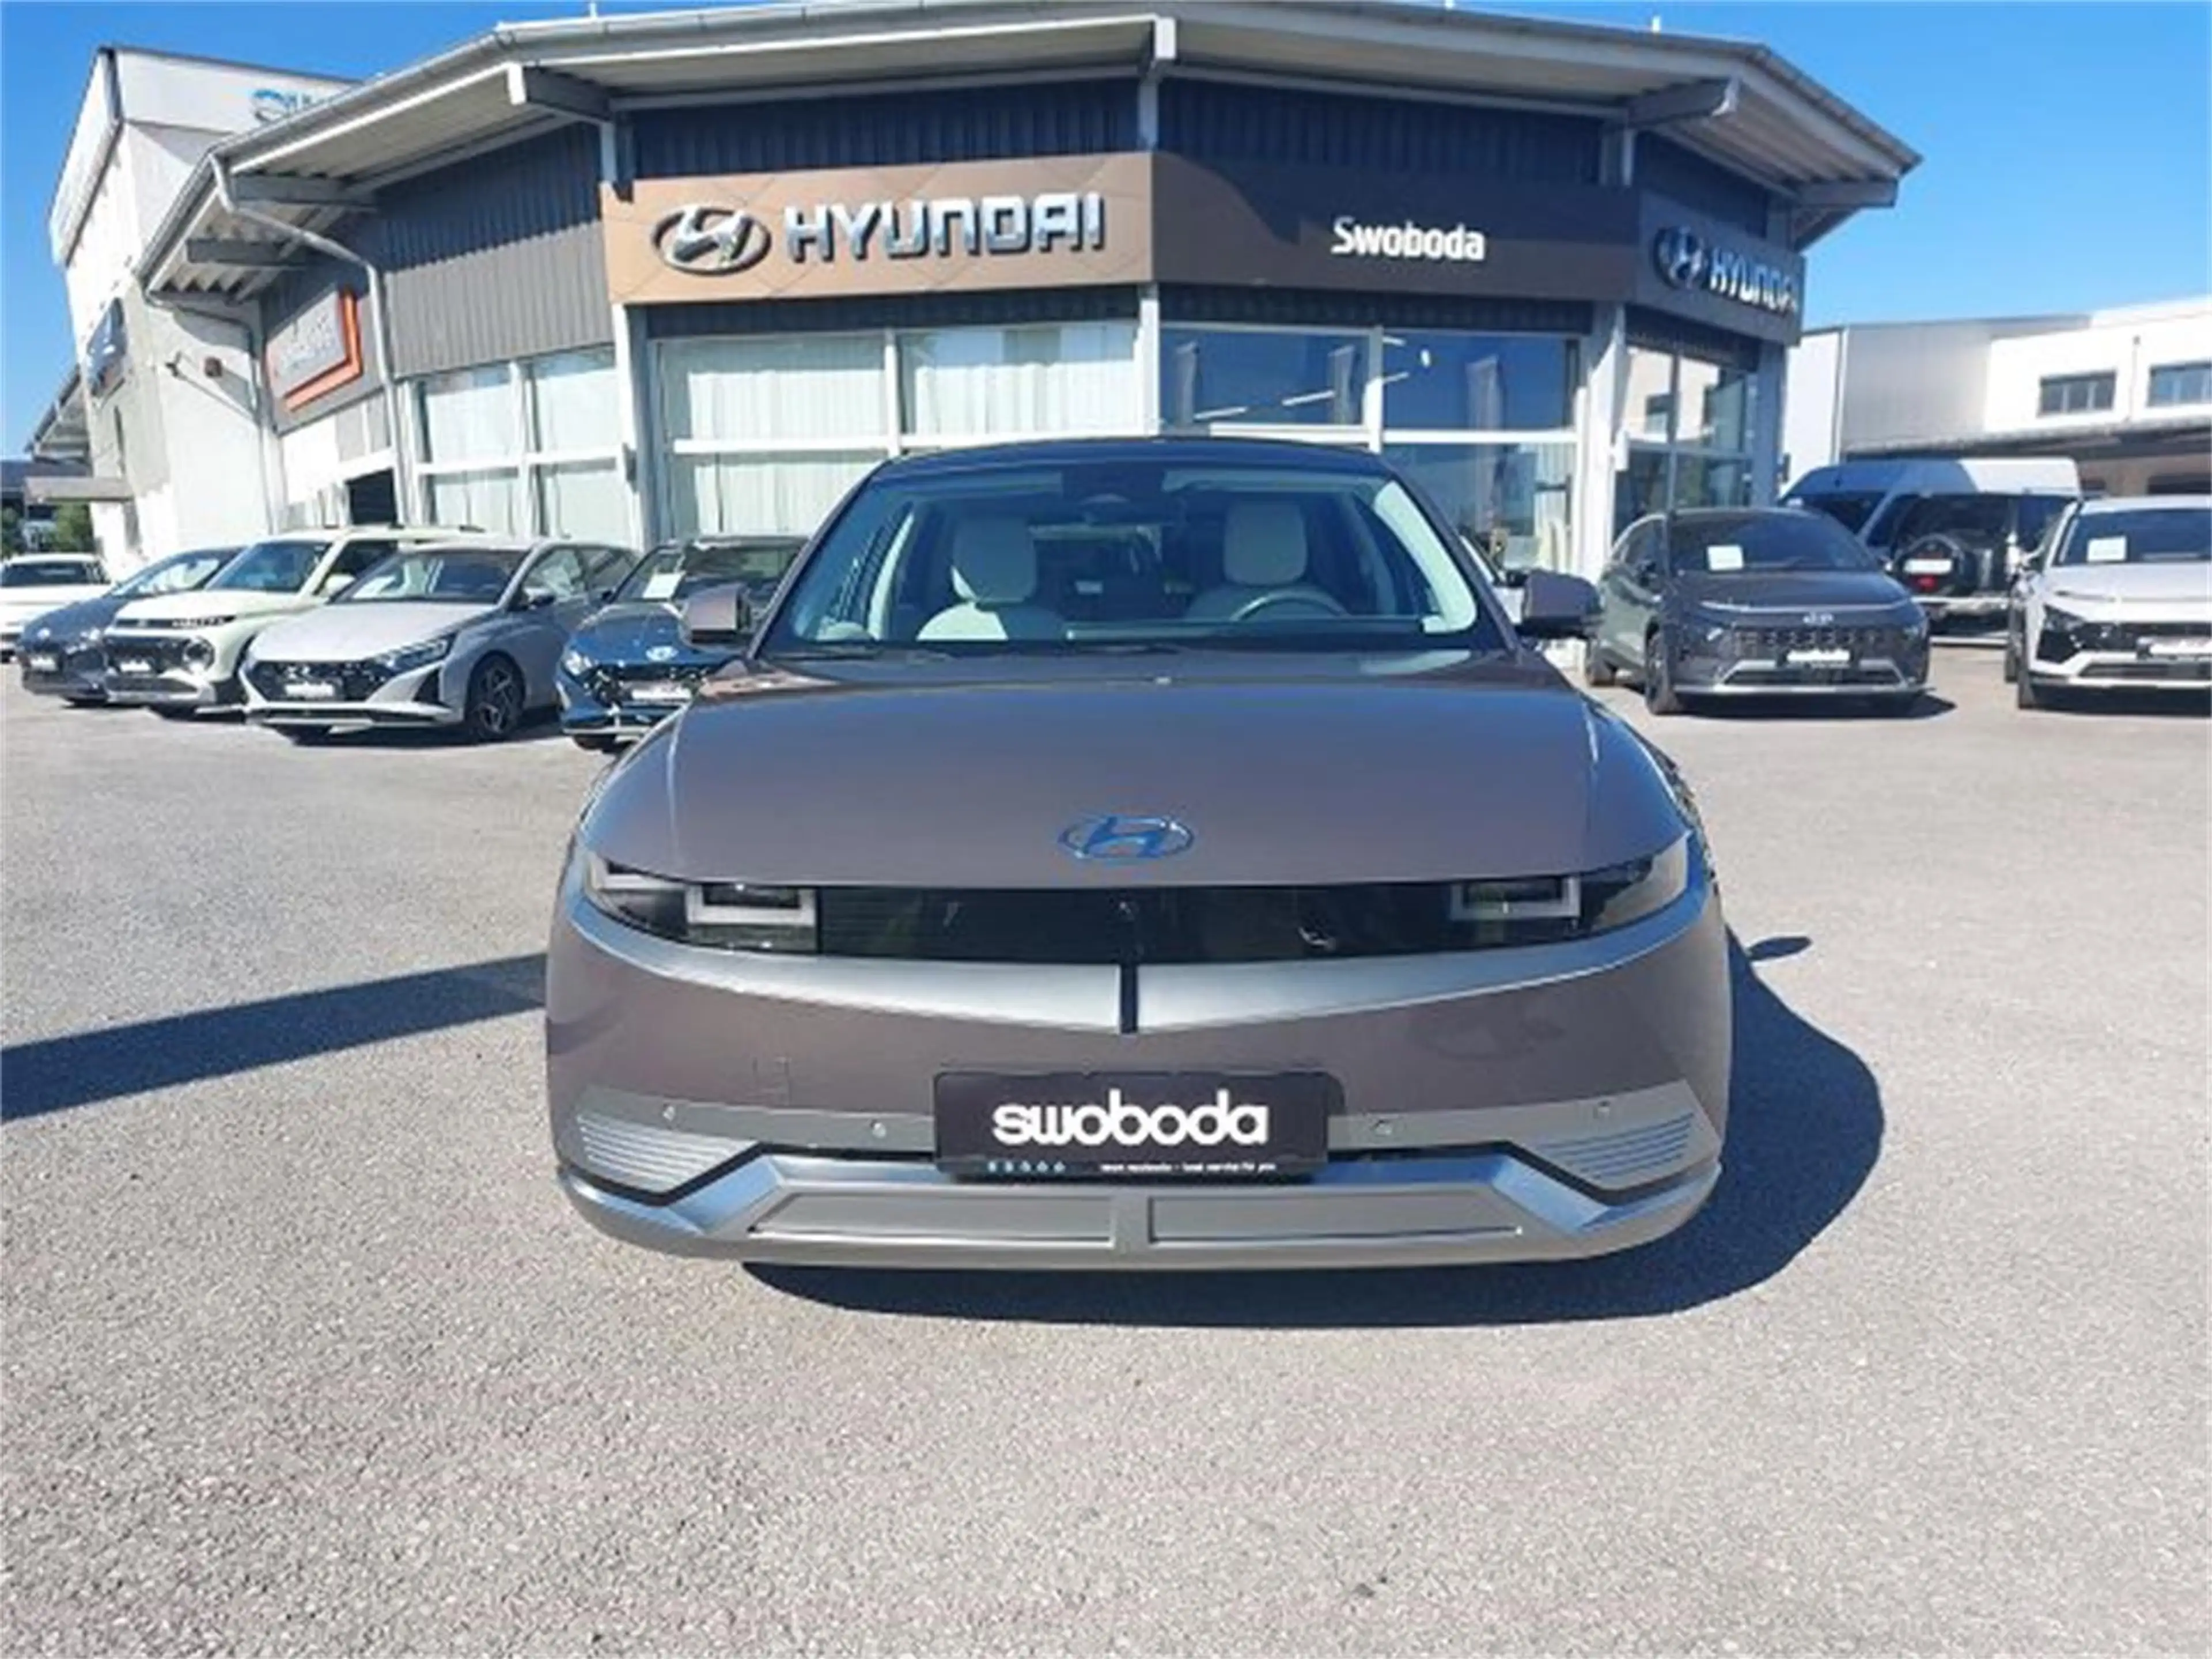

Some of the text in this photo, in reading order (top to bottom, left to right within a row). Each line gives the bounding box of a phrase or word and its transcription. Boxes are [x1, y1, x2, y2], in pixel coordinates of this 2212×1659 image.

[784, 191, 1104, 263] HYUNDAI
[1330, 215, 1486, 262] Swoboda
[993, 1089, 1268, 1145] swoboda
